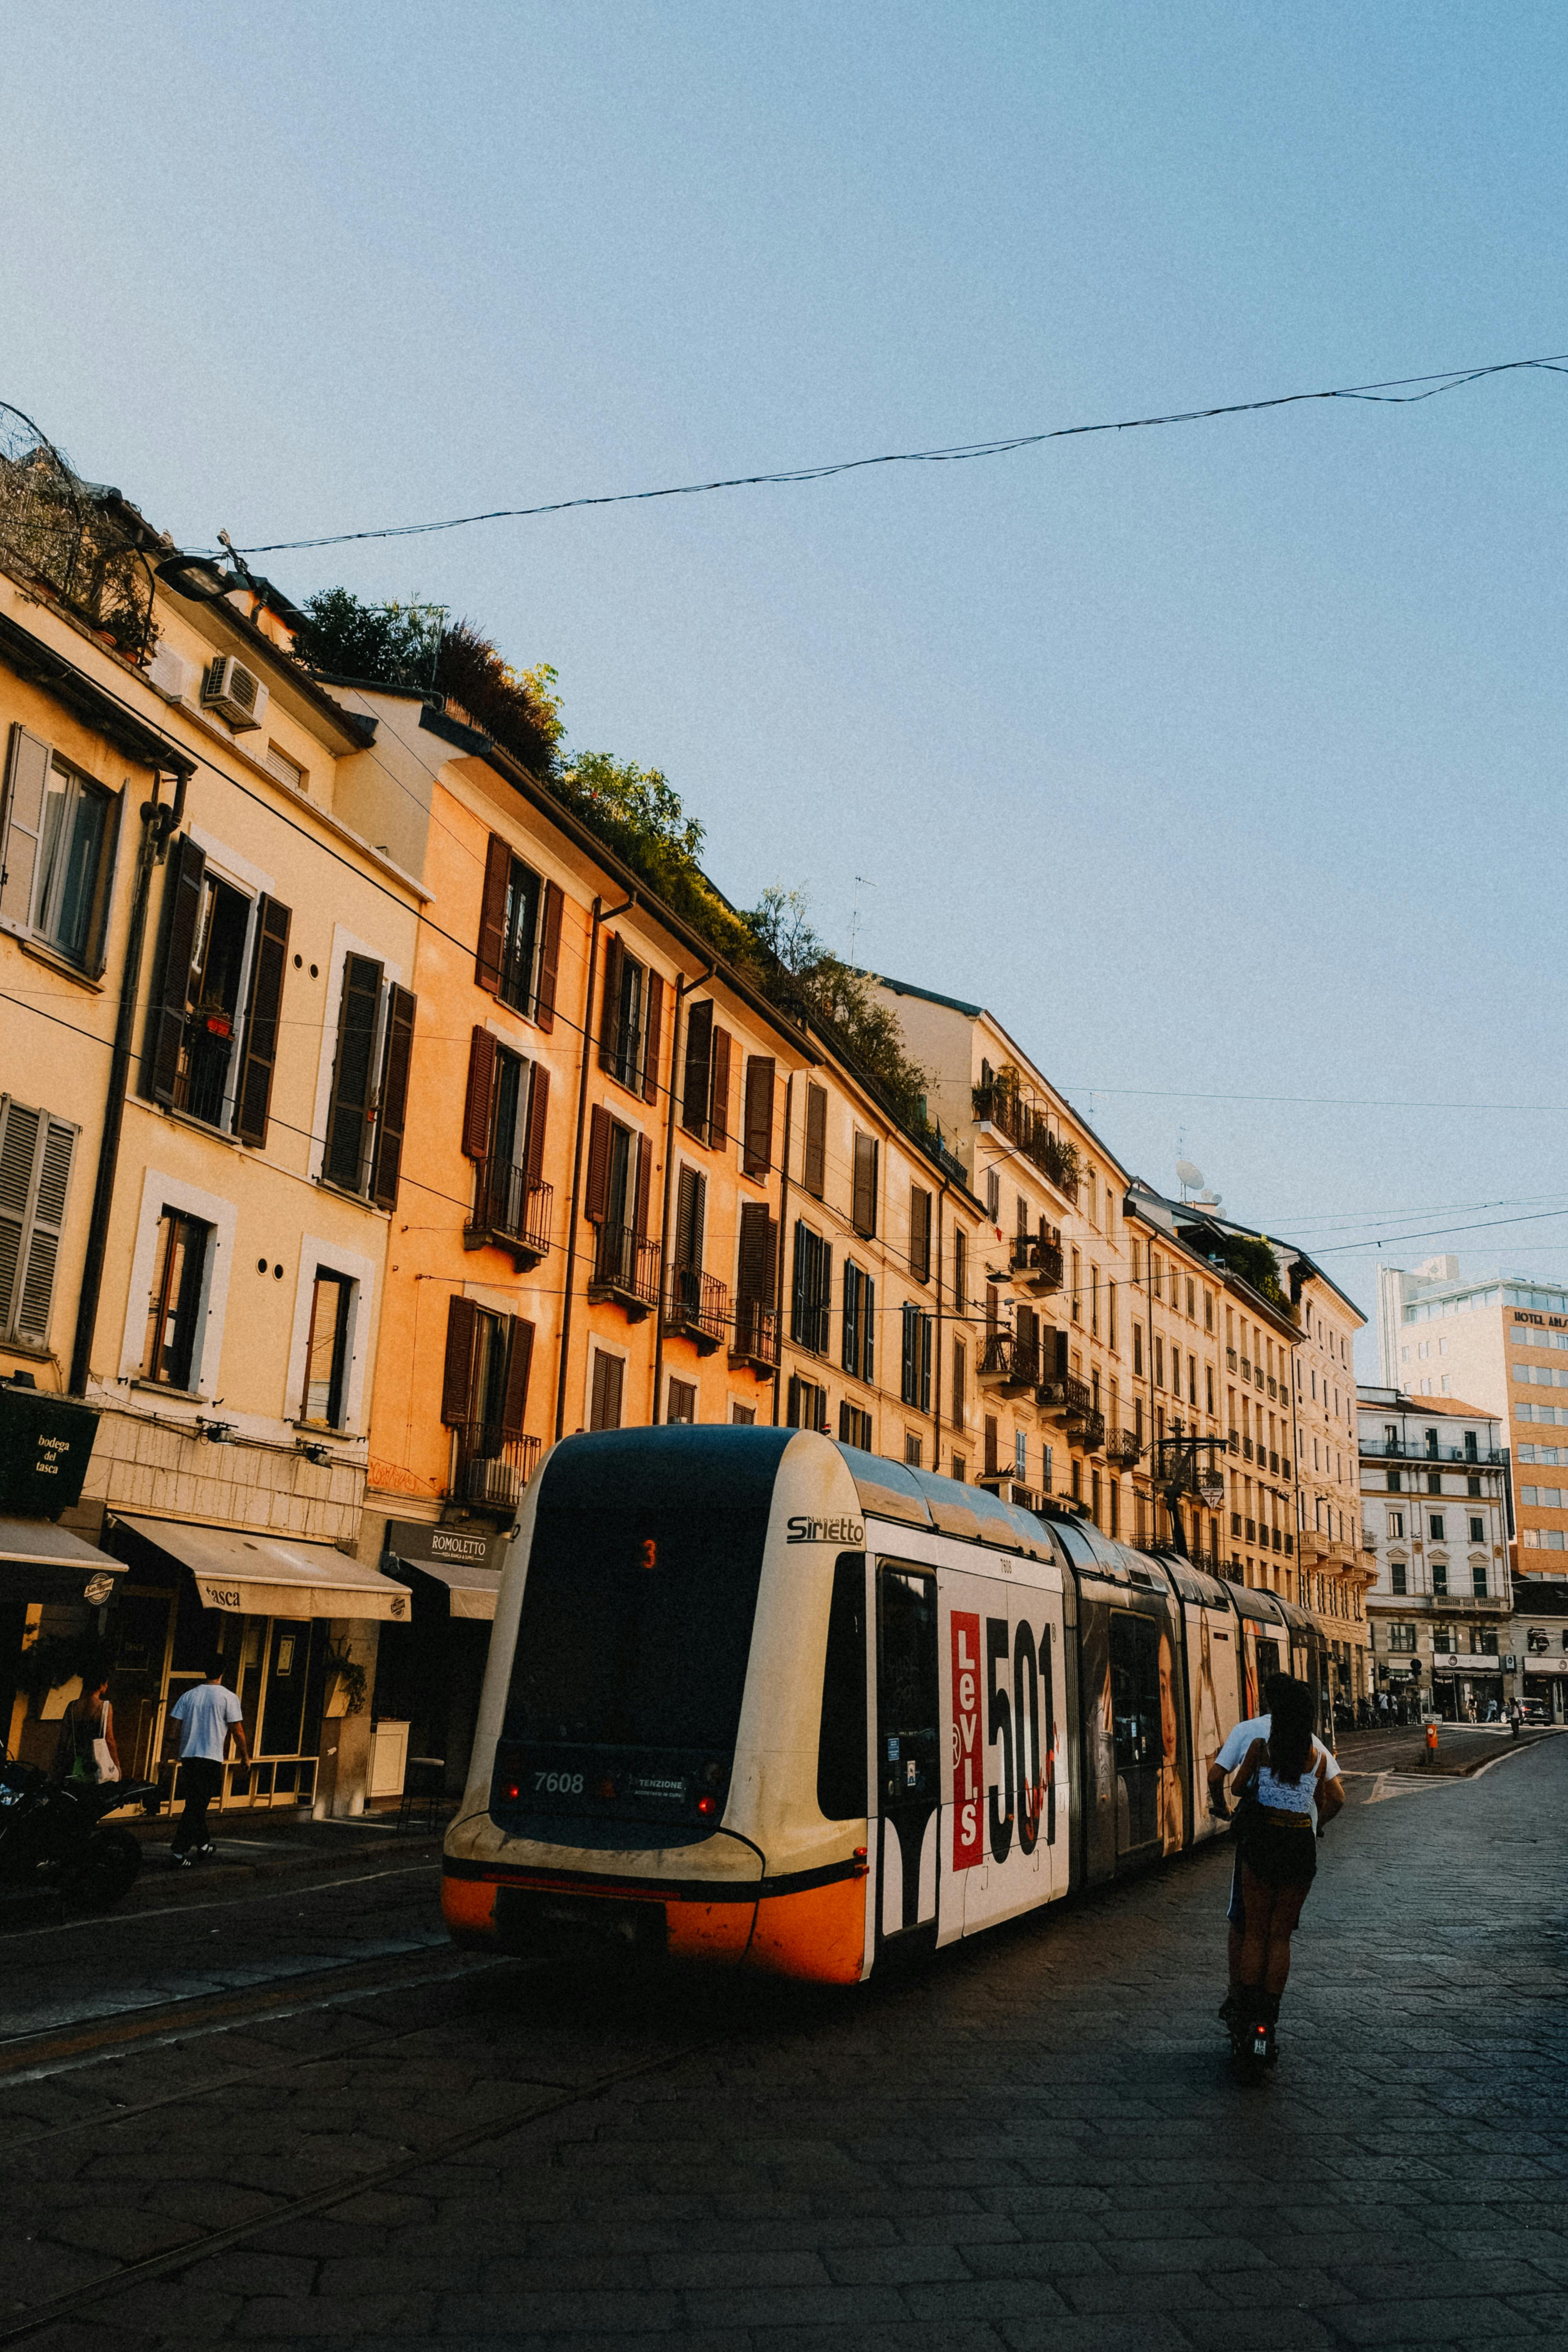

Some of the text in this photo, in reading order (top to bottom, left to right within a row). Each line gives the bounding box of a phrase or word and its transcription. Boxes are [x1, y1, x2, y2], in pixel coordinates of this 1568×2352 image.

[1514, 1312, 1545, 1325] HOTEL
[39, 1435, 69, 1452] bodega
[44, 1451, 56, 1461] del
[36, 1461, 58, 1474] tasca
[787, 1516, 864, 1542] Sirietto
[432, 1535, 486, 1555] ROMOLETTO
[642, 1539, 656, 1568] 3
[1000, 1558, 1012, 1574] 7608
[206, 1586, 240, 1606] tasca
[533, 1772, 584, 1793] 7608
